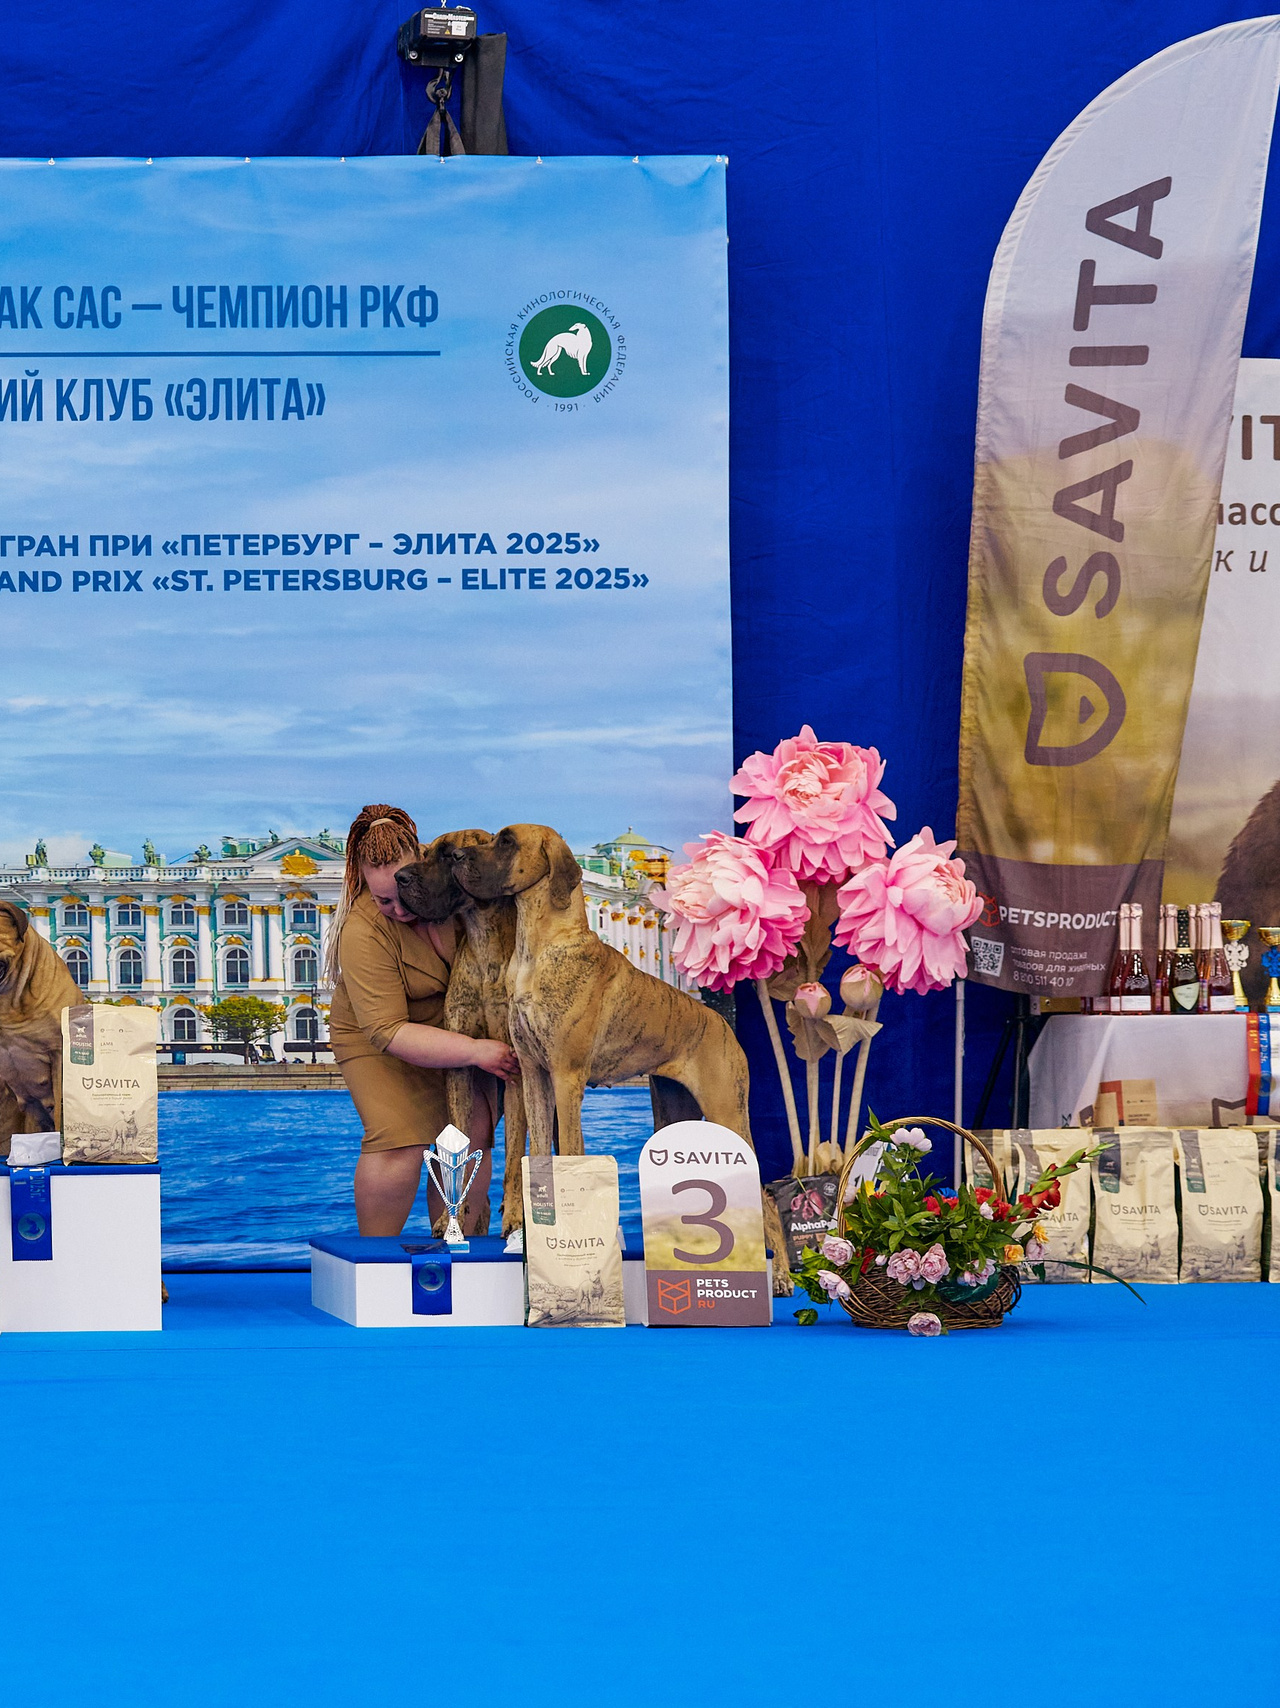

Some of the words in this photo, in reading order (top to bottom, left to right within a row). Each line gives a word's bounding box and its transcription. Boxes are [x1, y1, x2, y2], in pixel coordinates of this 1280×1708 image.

[173, 285, 347, 328] ЧЕМПИОН
[360, 285, 438, 328] РКФ
[517, 289, 621, 330] КИНОЛОГИЧЕСКАЯ
[505, 323, 540, 403] РОССИЙСКАЯ
[593, 334, 627, 403] ФЕДЕРАЦИЯ
[56, 378, 153, 421] КЛУБ
[165, 378, 326, 421] «ЭЛИТА»
[554, 403, 579, 412] 1991
[1042, 176, 1172, 619] SAVITA
[0, 535, 78, 557] ГРАН
[90, 535, 152, 556] ПРИ
[162, 534, 359, 556] «ПЕТЕРБУРГ
[393, 533, 497, 555] ЭЛИТА
[507, 533, 599, 554] 2025»
[73, 570, 143, 592] PRIX
[153, 570, 213, 591] «ST.
[224, 569, 427, 591] PETERSBURG
[462, 568, 546, 590] ELITE
[556, 568, 649, 589] 2025»
[999, 905, 1119, 930] PETSPRODUCT
[95, 1078, 140, 1089] SAVITA
[673, 1151, 747, 1165] SAVITA
[1122, 1204, 1161, 1215] SAVITA
[1209, 1204, 1248, 1215] SAVITA
[671, 1179, 735, 1265] 3
[559, 1237, 605, 1249] SAVITA
[696, 1279, 729, 1288] PETS
[697, 1289, 758, 1299] PRODUCT
[698, 1300, 716, 1309] RU
